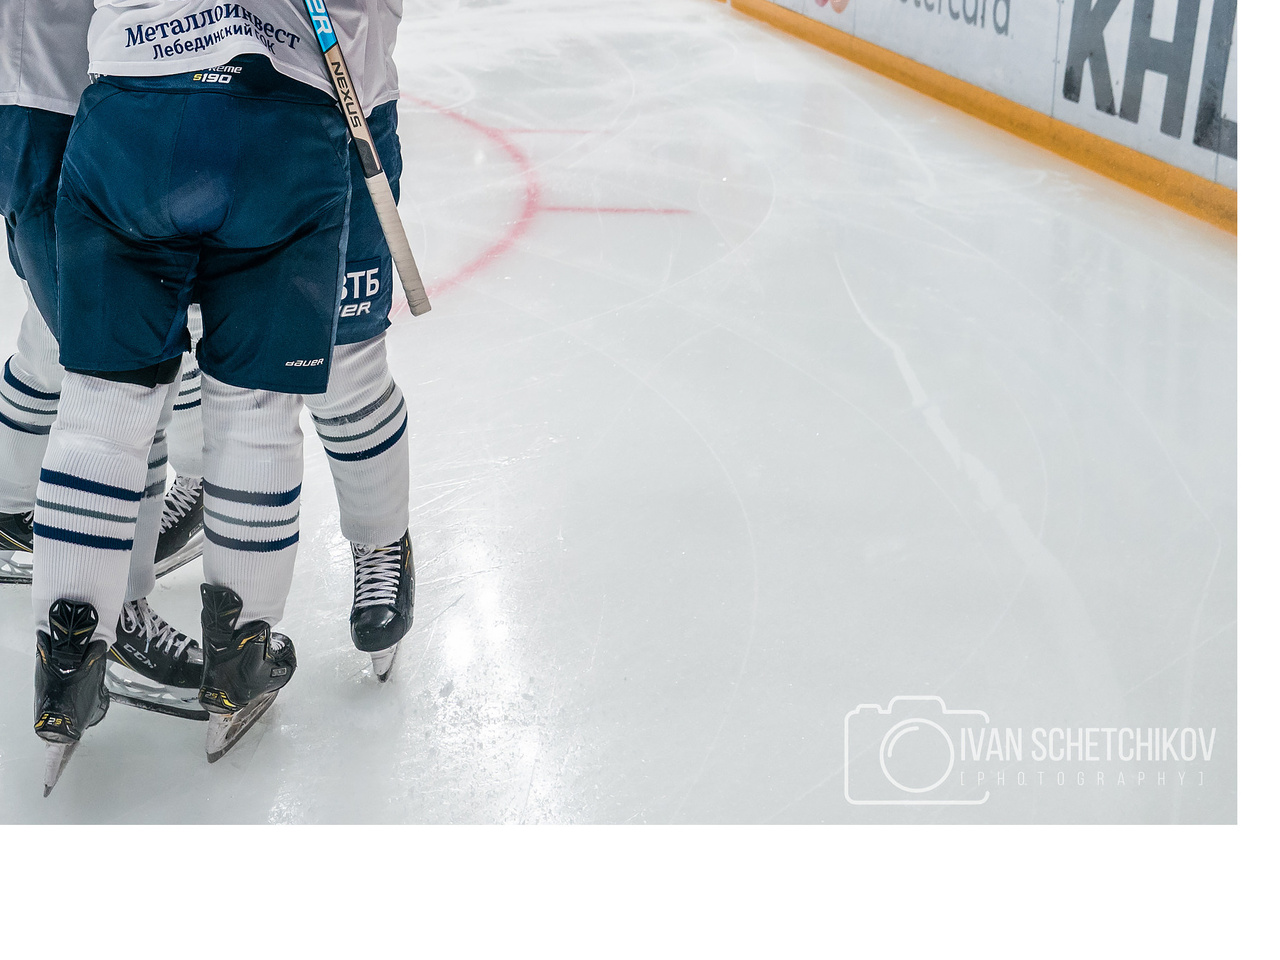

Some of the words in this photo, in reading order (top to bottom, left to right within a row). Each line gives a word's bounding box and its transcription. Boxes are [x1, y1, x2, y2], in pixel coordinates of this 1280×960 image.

[125, 3, 301, 50] Металлоинвест
[152, 23, 254, 60] Лебединский
[331, 61, 362, 128] NEXUS
[123, 642, 157, 669] CCM
